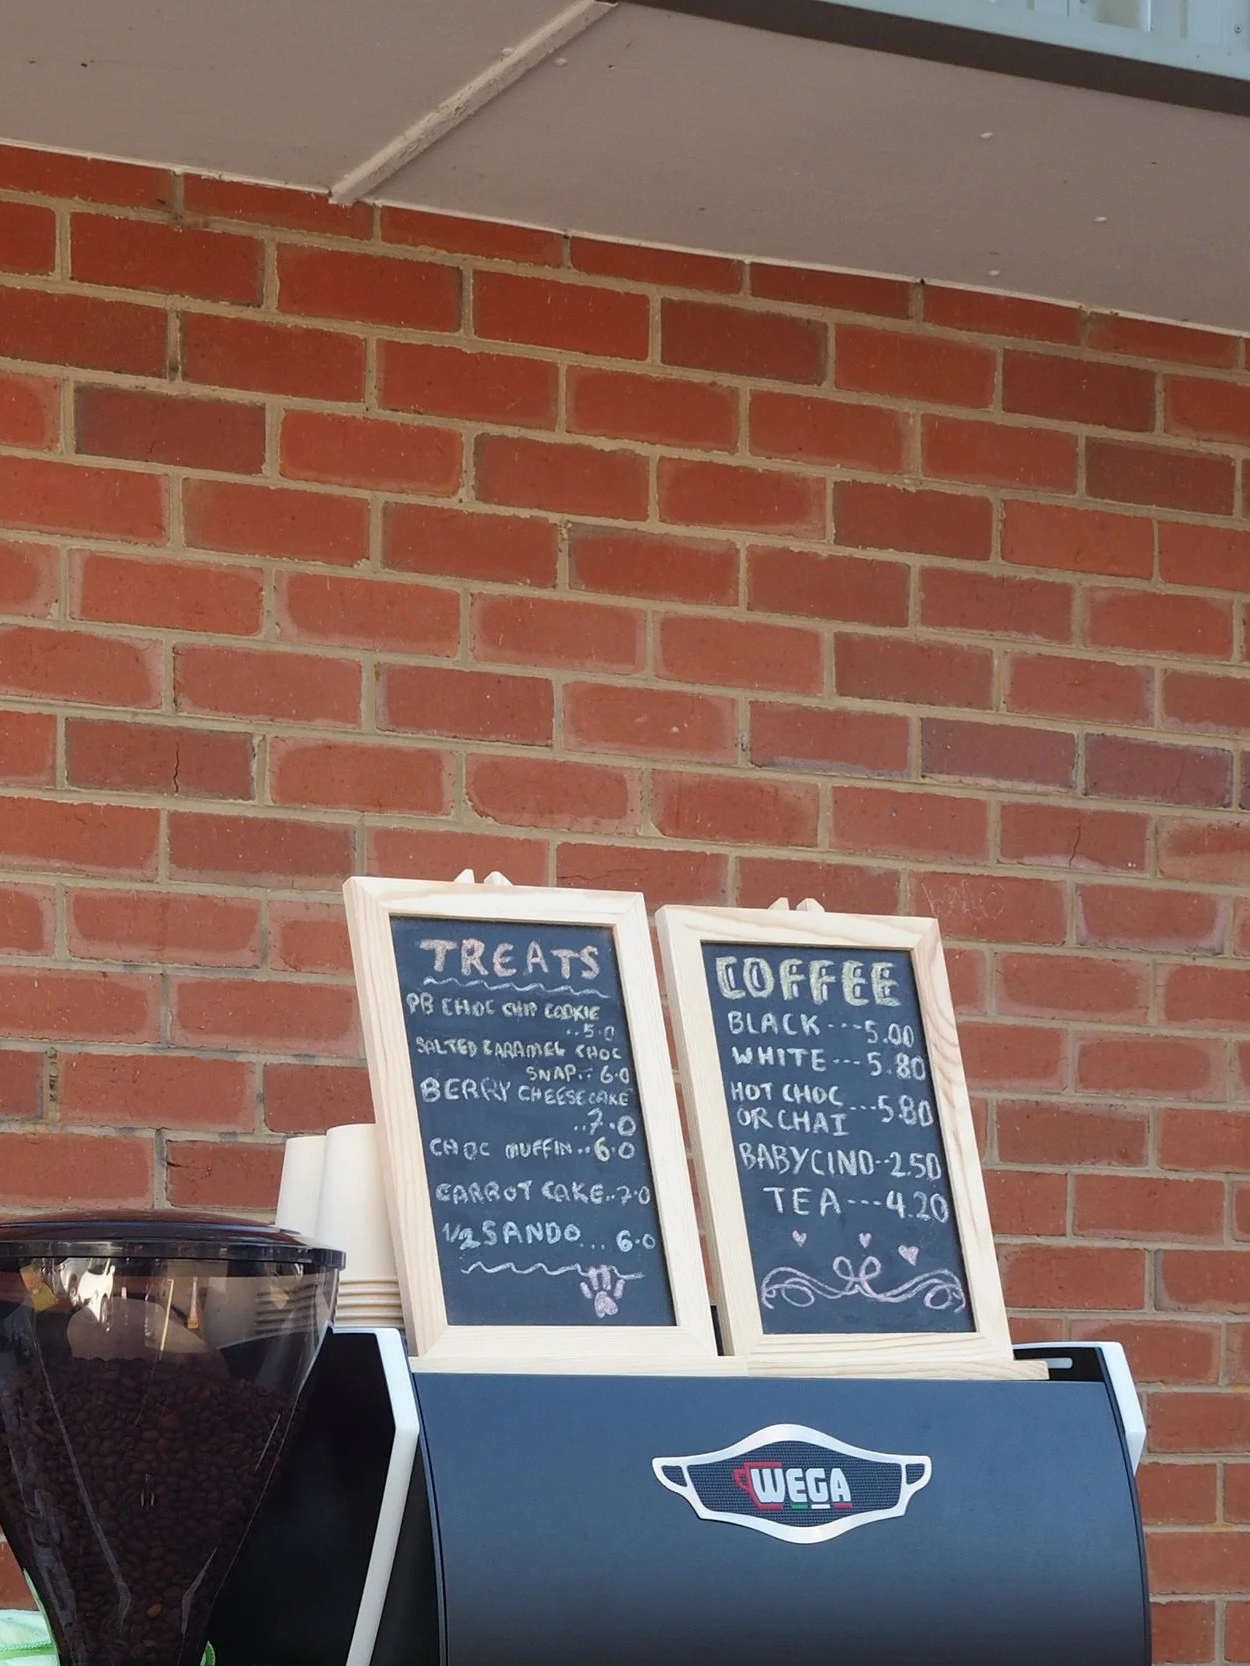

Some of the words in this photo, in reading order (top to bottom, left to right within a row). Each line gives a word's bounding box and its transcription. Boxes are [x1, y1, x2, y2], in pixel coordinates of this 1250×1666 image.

[417, 937, 600, 980] TREATS
[715, 955, 902, 1007] COFFEE
[405, 992, 434, 1016] PB
[441, 998, 496, 1017] CHOC
[502, 1002, 538, 1018] CHIP
[544, 1003, 600, 1022] COOKIE
[727, 1009, 821, 1036] BLACK
[415, 1036, 478, 1058] SALTED
[482, 1039, 566, 1059] CARAMEL
[575, 1044, 623, 1061] CHOC
[731, 1046, 827, 1073] WHITE
[419, 1076, 511, 1103] BERRY
[730, 1081, 774, 1102] HOT
[781, 1083, 844, 1107] CHOC
[736, 1107, 774, 1131] OR
[777, 1109, 849, 1137] CHAI
[429, 1137, 491, 1161] CHOC
[435, 1180, 534, 1205] CARROT
[762, 1186, 842, 1217] TEA
[748, 1466, 852, 1505] WEGA
